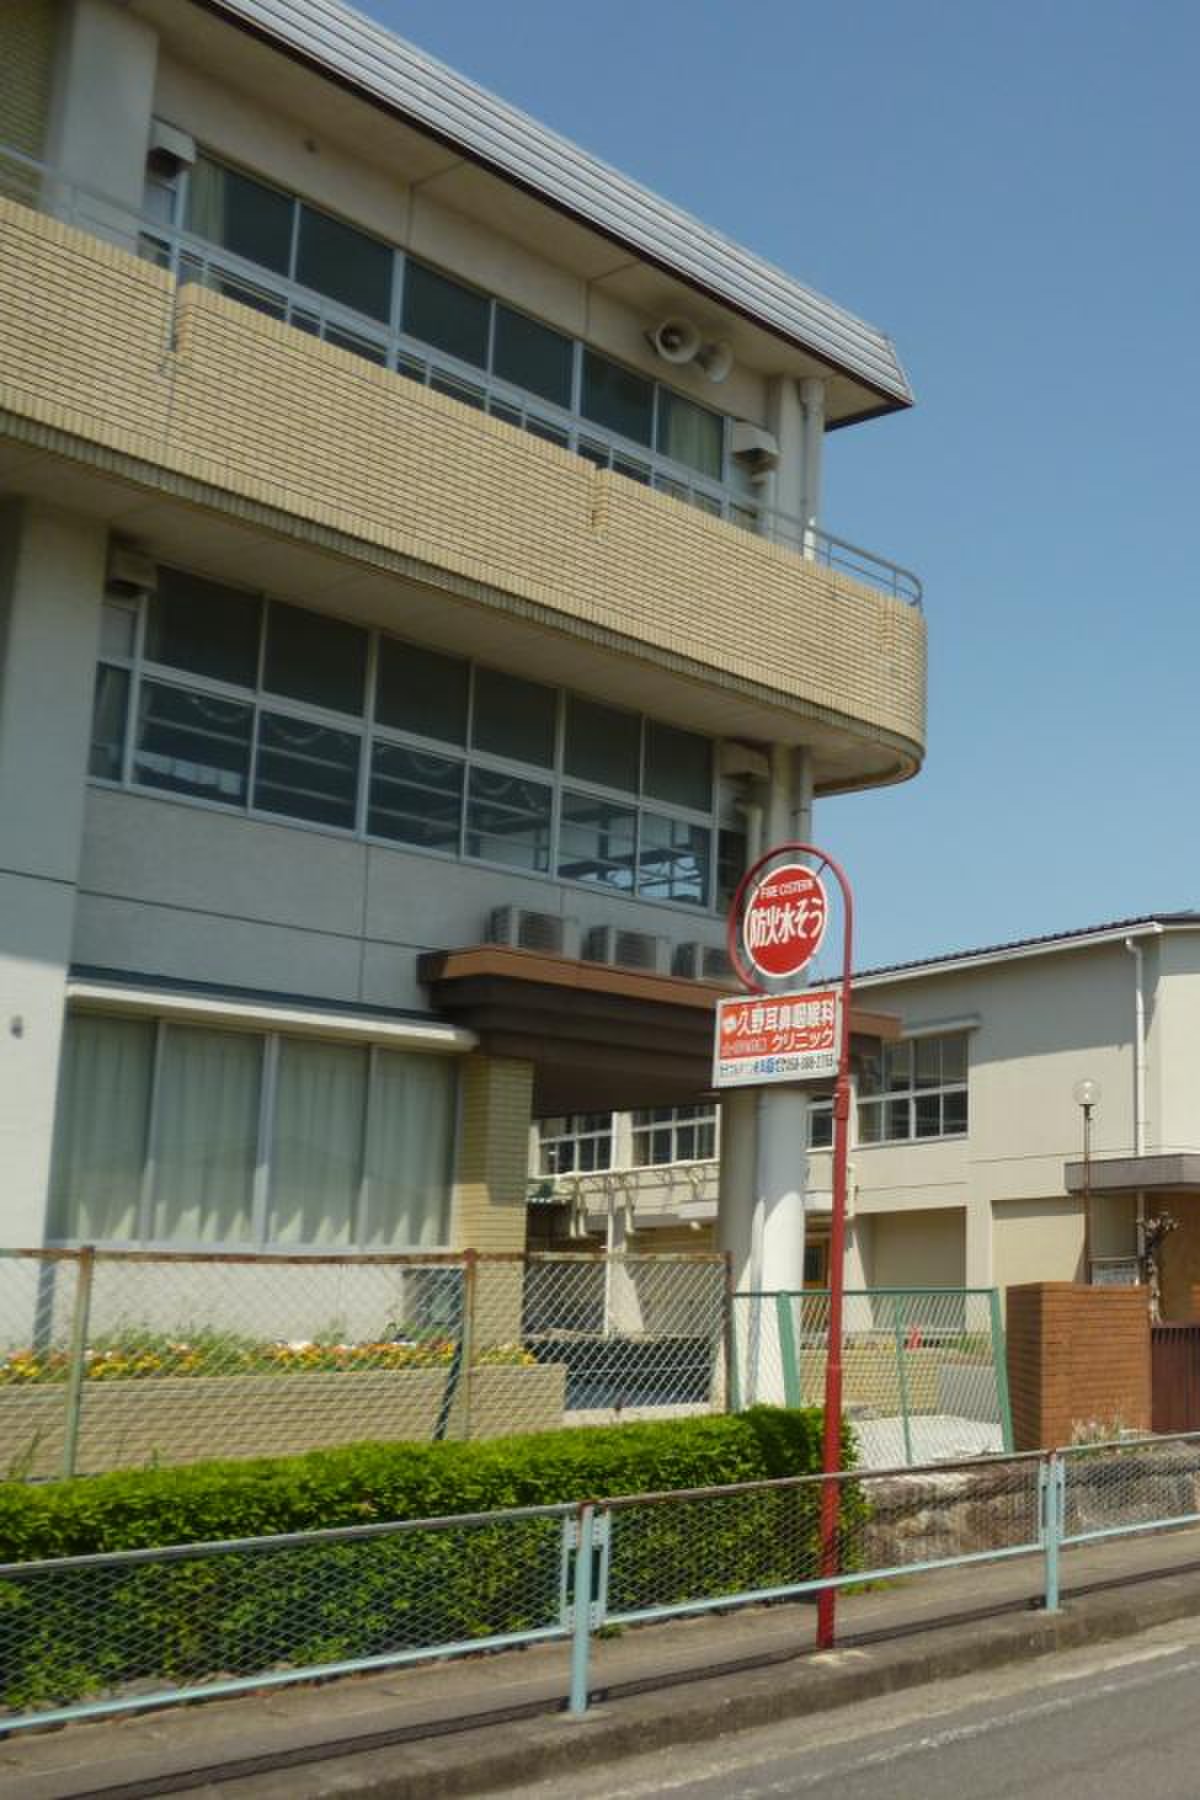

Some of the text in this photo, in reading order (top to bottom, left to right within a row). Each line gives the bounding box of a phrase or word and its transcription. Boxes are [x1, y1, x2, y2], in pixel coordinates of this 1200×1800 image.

[751, 897, 824, 948] 防火水そう
[770, 1029, 835, 1052] クリニック
